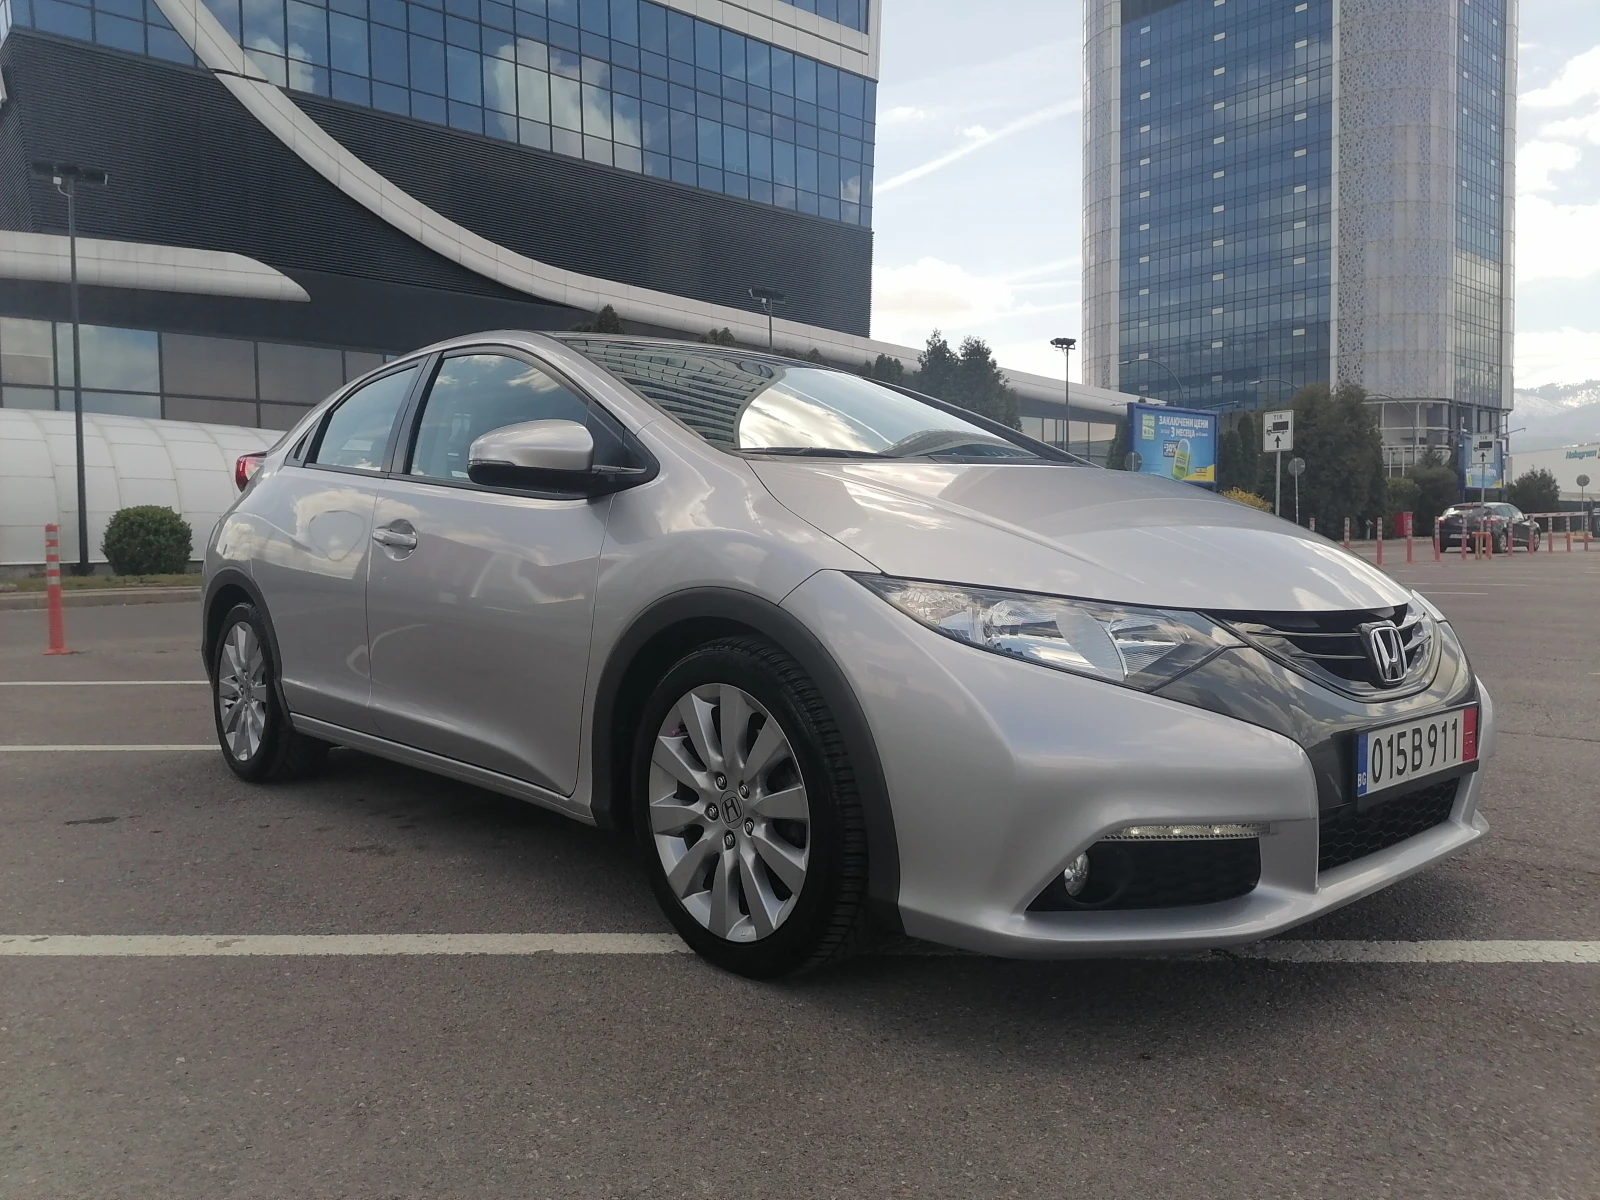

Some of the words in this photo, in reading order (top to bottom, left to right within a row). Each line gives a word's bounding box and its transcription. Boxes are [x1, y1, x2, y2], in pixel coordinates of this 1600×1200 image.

[1159, 416, 1194, 427] ЗАКЛЮЧЕНИ
[1194, 419, 1208, 429] ЦЕНИ
[1171, 427, 1175, 437] 3
[1176, 428, 1195, 438] МЕСЕЦА
[1357, 773, 1367, 788] BG
[1372, 718, 1457, 783] 015B911
